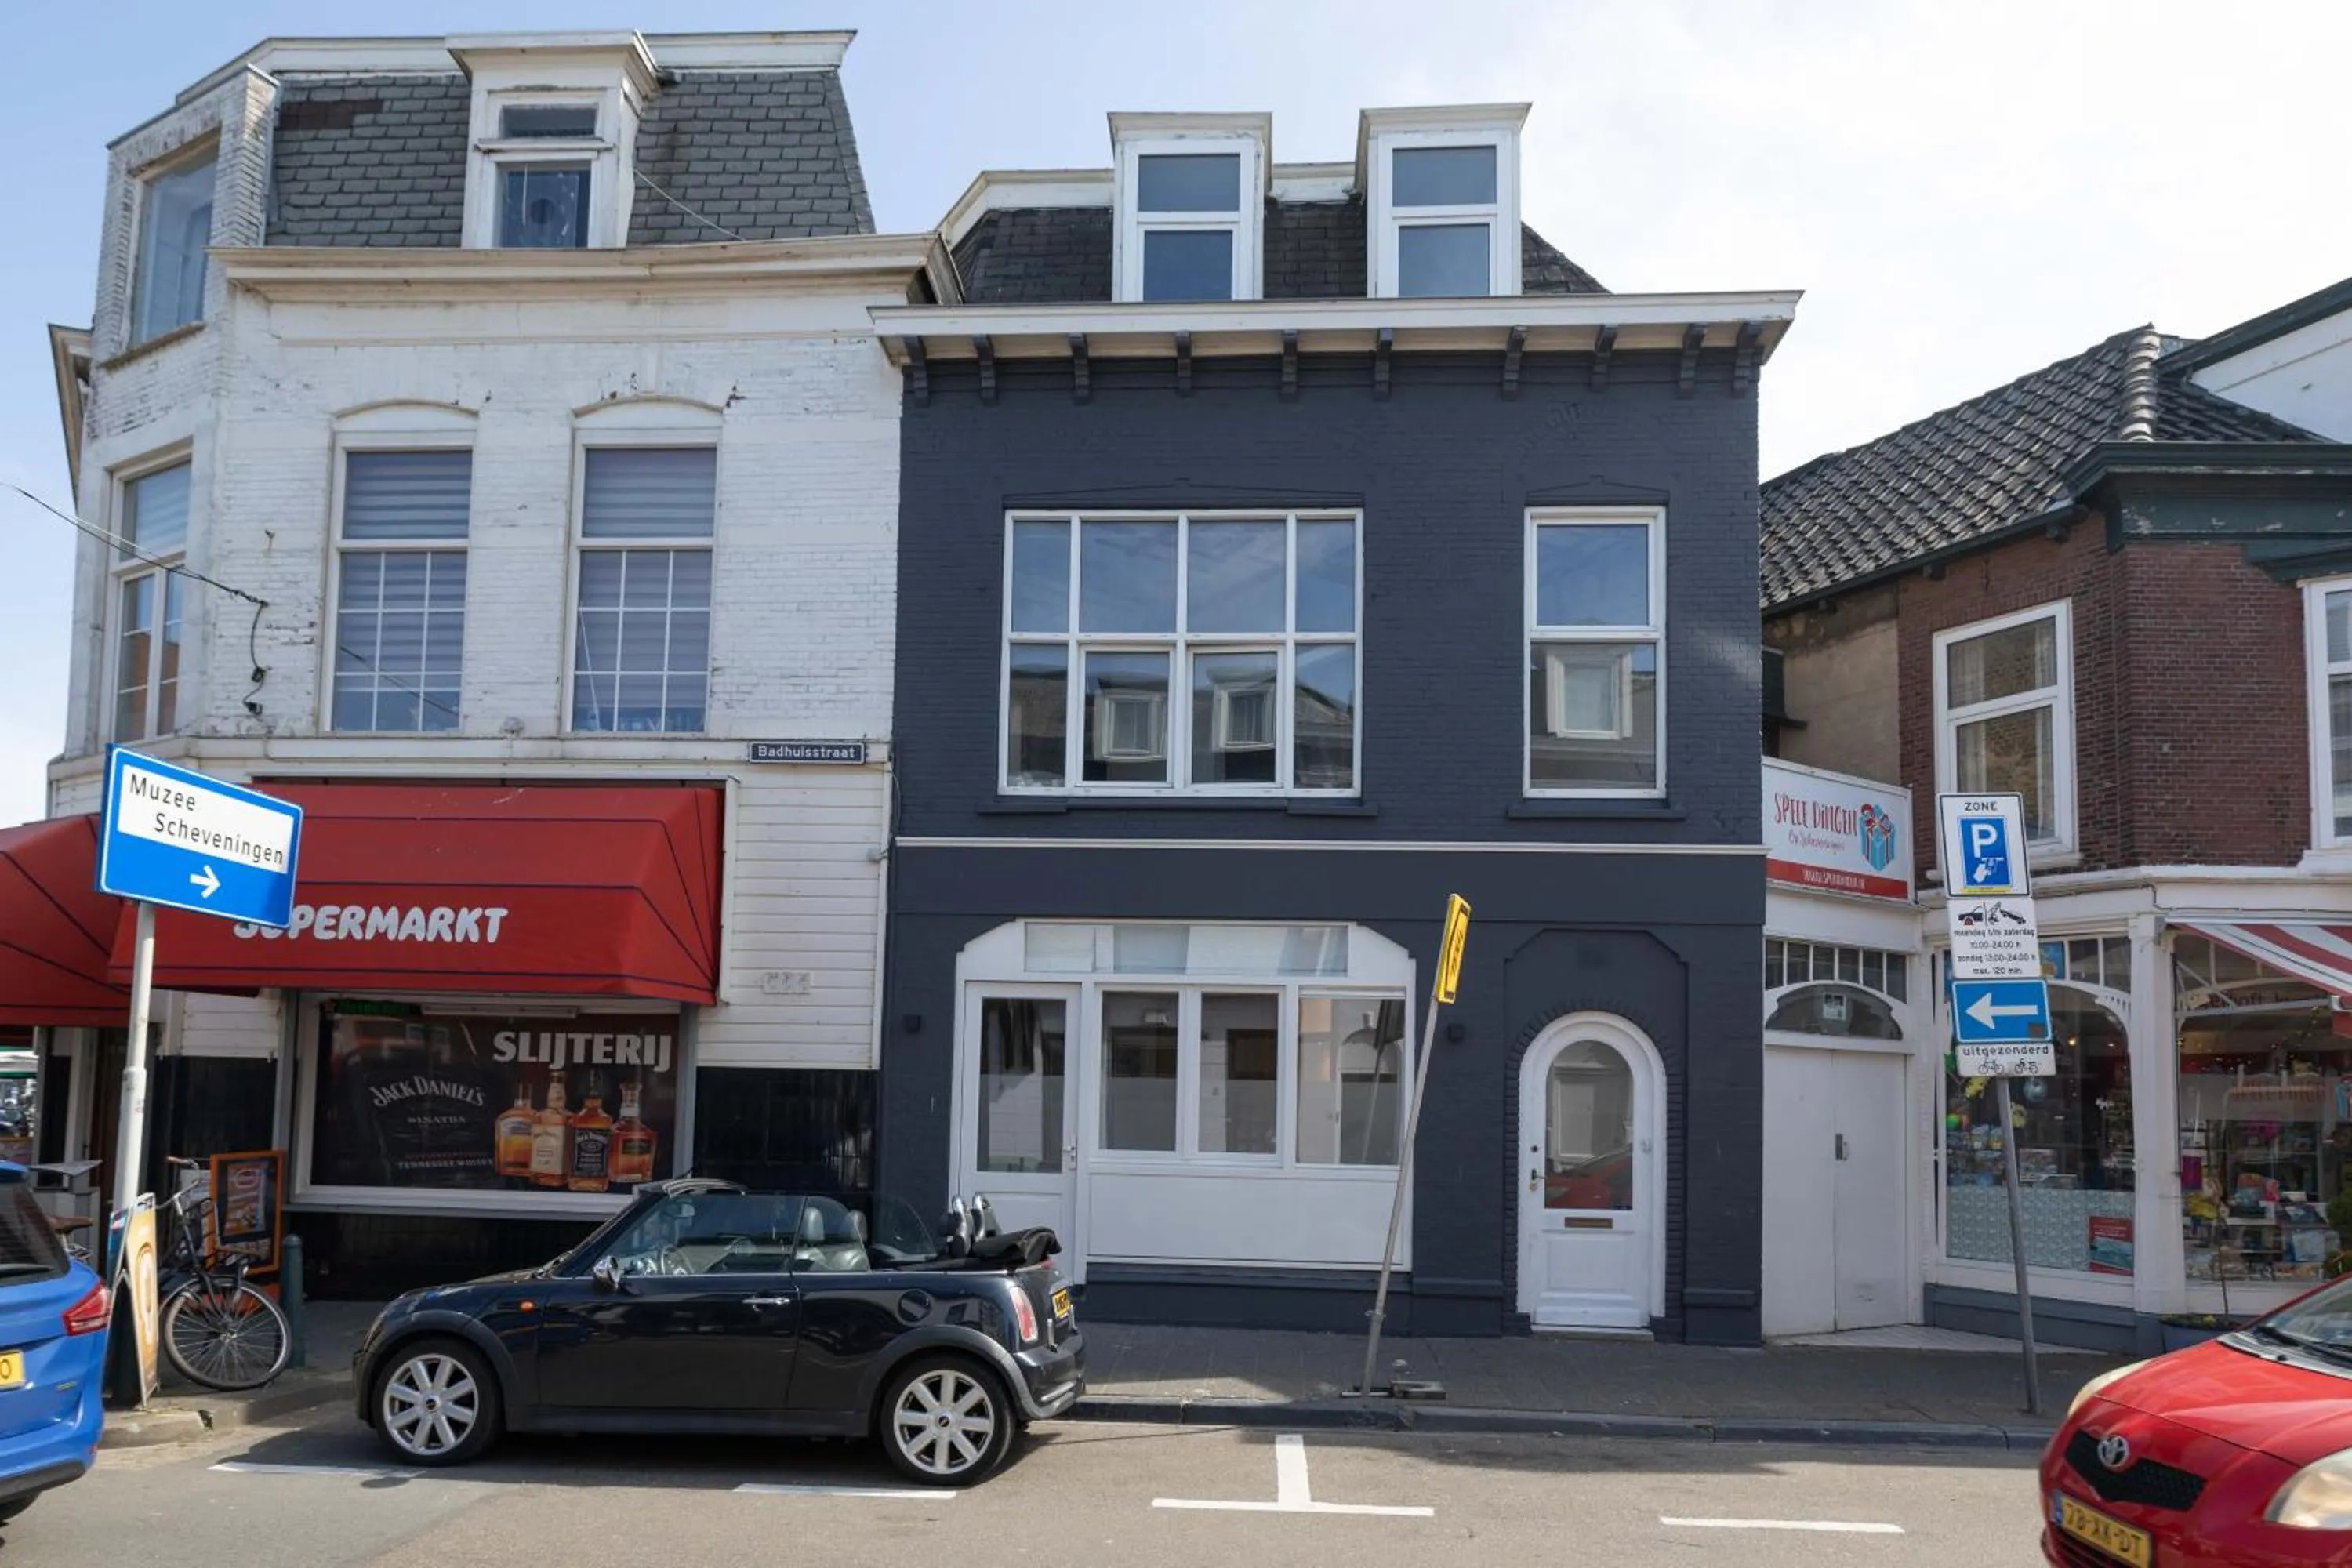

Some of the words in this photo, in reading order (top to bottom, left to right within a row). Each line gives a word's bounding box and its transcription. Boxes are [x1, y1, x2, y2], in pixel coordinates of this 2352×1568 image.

[758, 746, 855, 758] Badhuisstraat
[130, 774, 196, 811] Muzee
[1964, 801, 1998, 811] ZONE
[154, 812, 284, 865] Scheveningen
[1970, 823, 1998, 858] P
[2004, 928, 2035, 938] zaterdag
[1957, 954, 1984, 963] zondag
[492, 1031, 673, 1073] SLIJTERIJ
[1962, 1045, 2049, 1057] uitgezonderd
[368, 1080, 416, 1106] JACK
[413, 1075, 485, 1107] DANIEL'S
